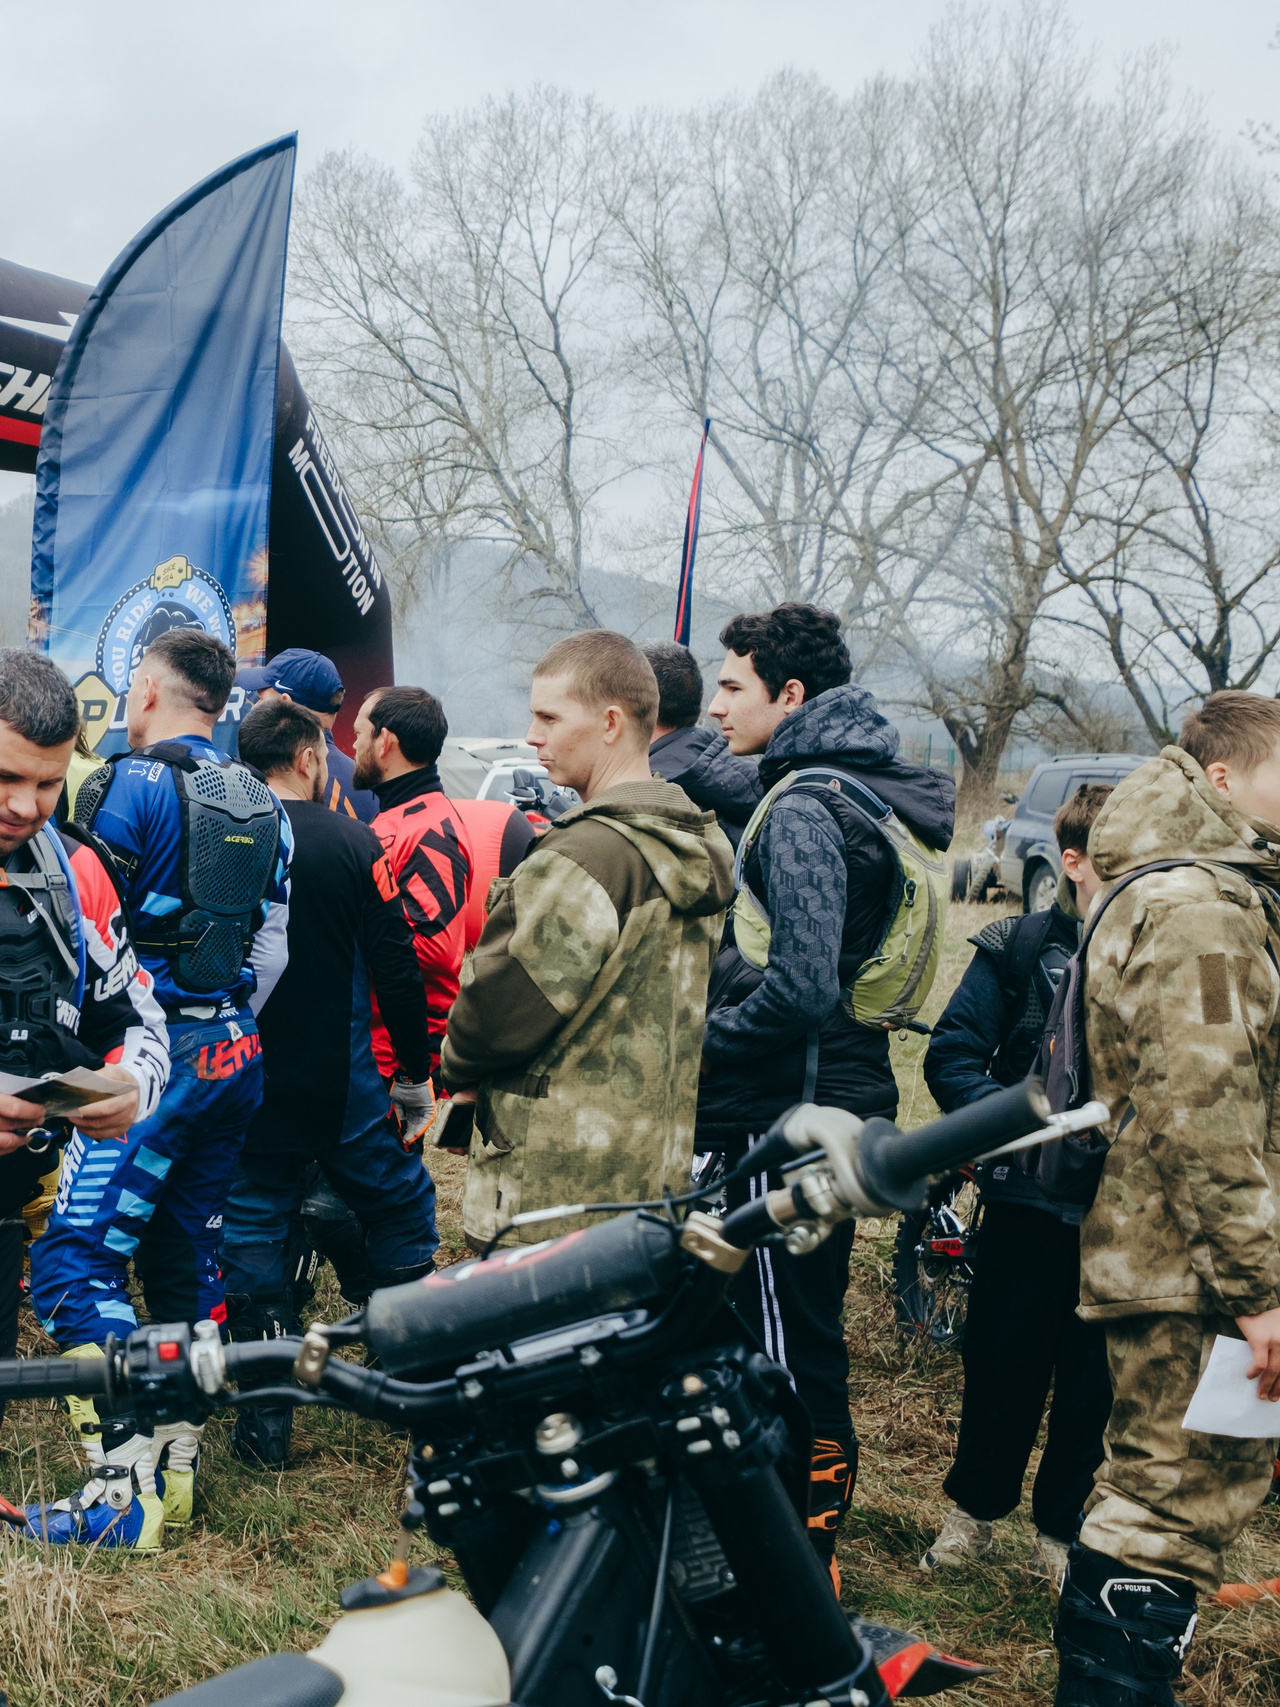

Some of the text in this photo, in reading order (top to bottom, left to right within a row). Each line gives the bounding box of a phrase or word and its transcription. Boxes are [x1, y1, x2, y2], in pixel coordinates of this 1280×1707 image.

[288, 437, 375, 616] MOTION
[116, 594, 154, 642] RIDE
[185, 583, 214, 614] WE
[111, 646, 126, 690] YOU
